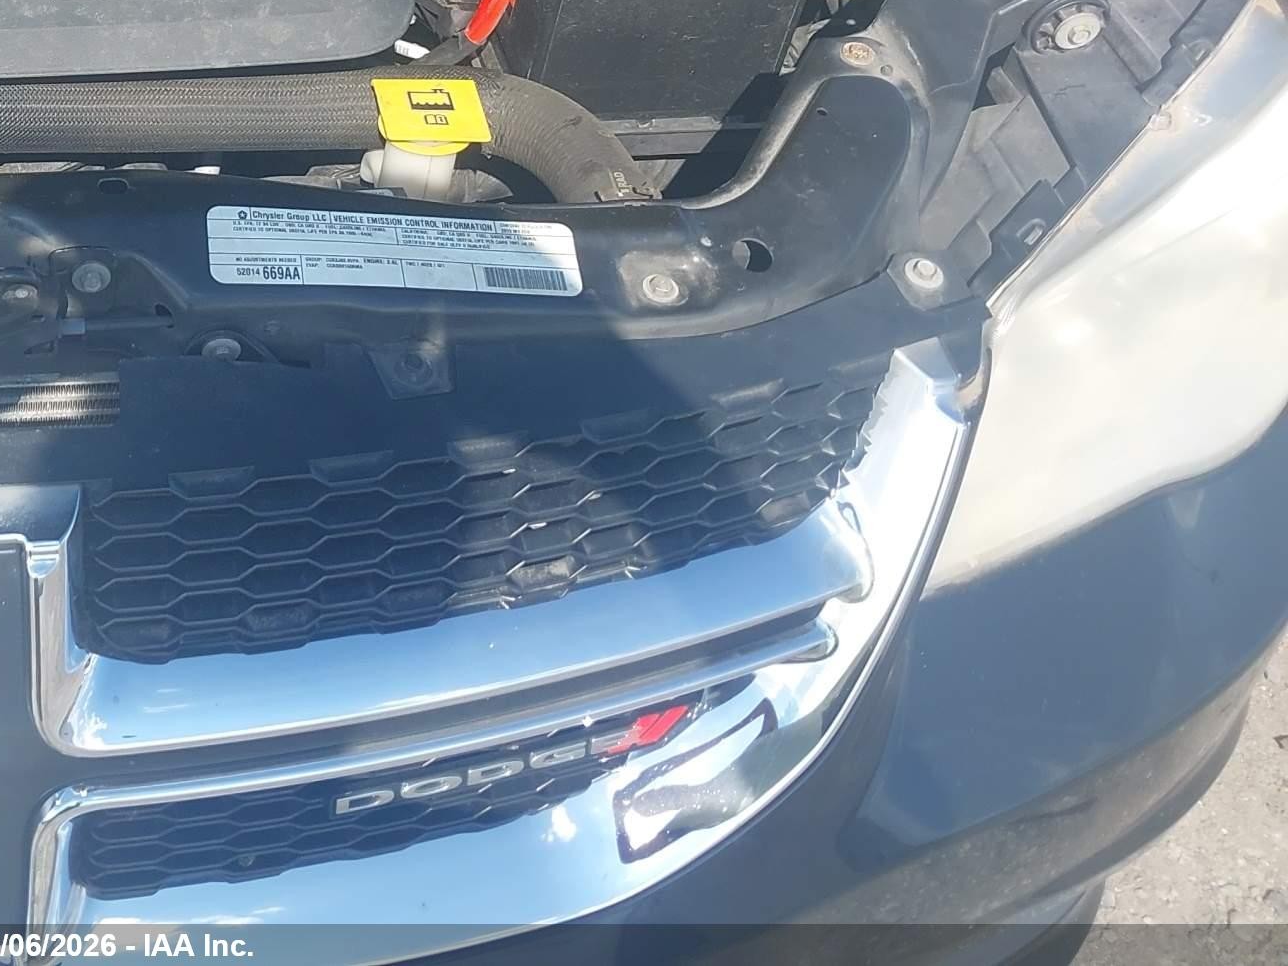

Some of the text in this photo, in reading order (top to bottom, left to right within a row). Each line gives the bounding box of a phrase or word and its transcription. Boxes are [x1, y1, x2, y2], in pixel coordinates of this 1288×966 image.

[252, 210, 328, 222] Chrysler Group LLC
[333, 215, 363, 224] VEHICLE
[366, 216, 403, 226] EMISSION
[404, 218, 440, 228] CONTROL
[441, 220, 493, 232] INFORMATION
[236, 267, 301, 280] 52014 669AA
[335, 732, 634, 815] DODGE
